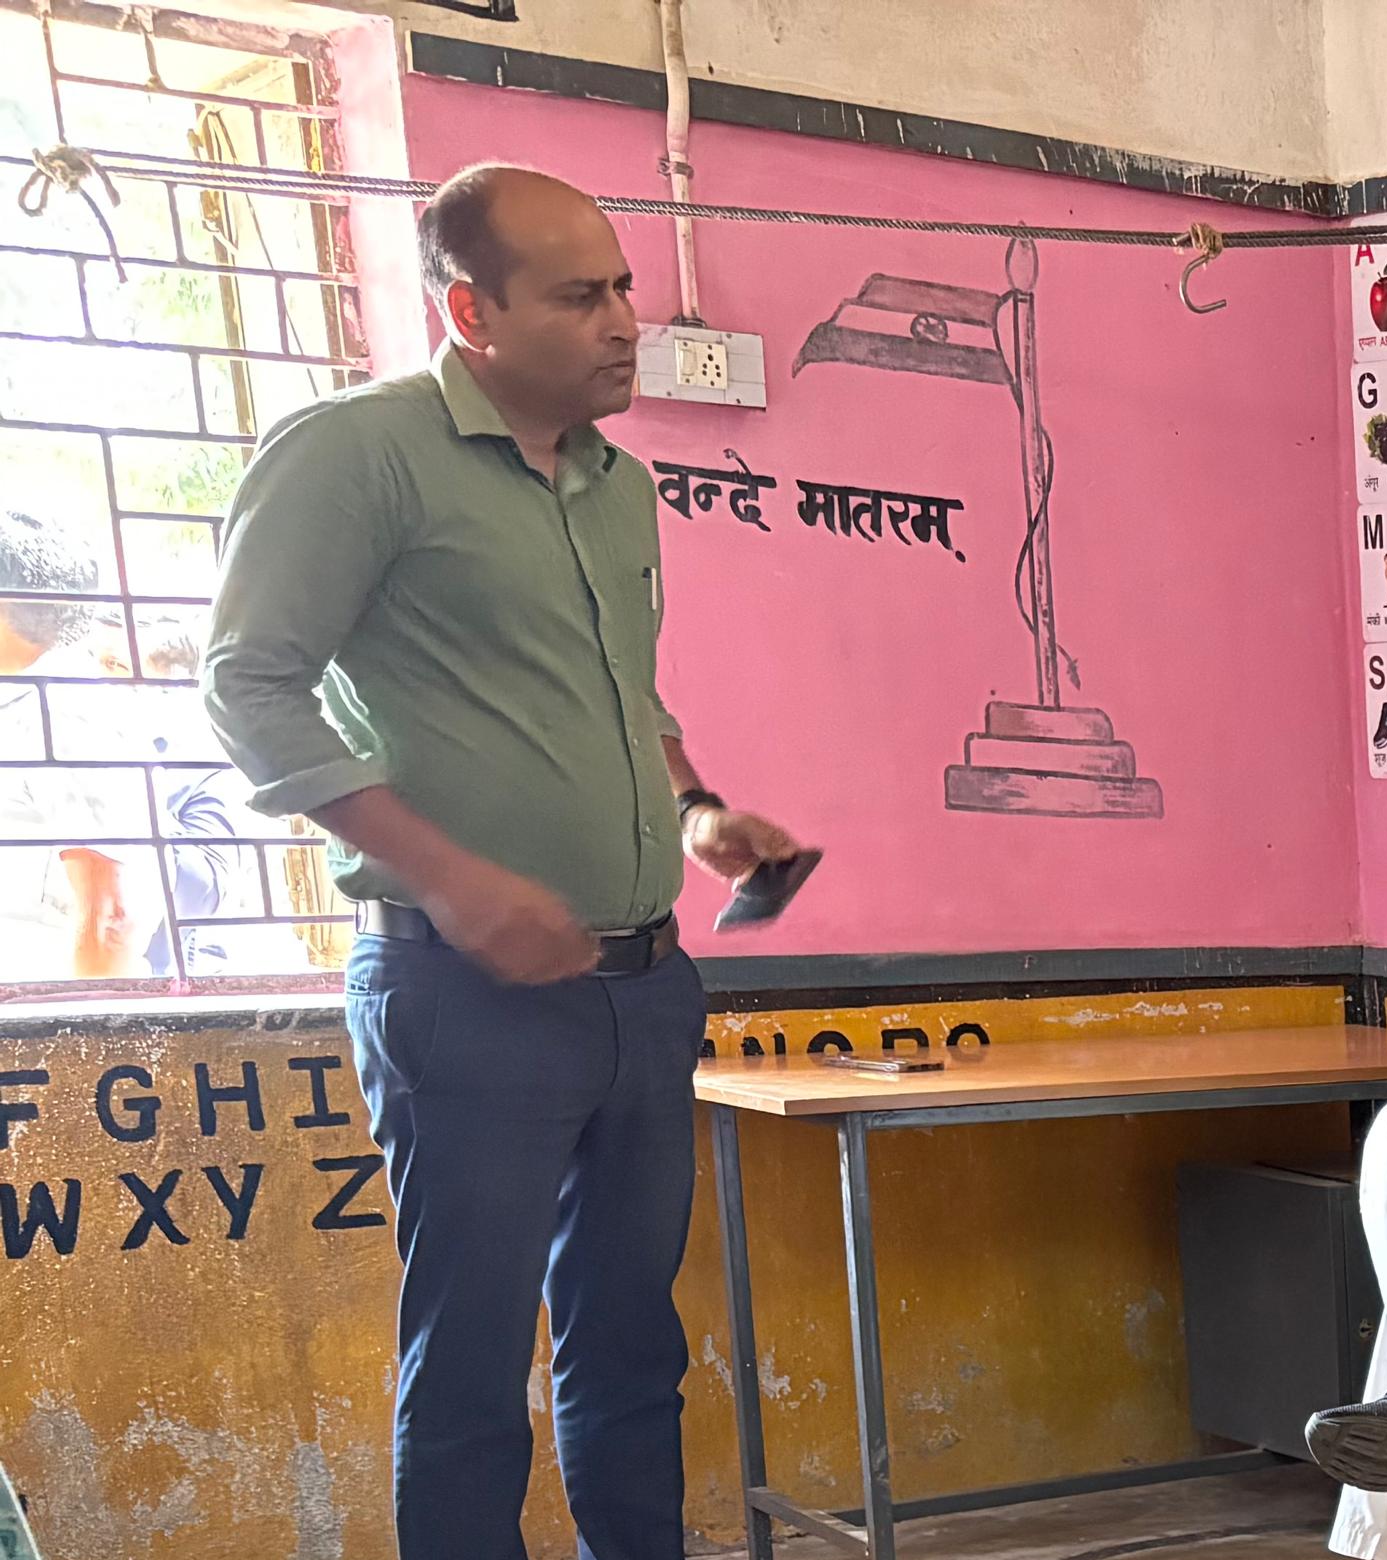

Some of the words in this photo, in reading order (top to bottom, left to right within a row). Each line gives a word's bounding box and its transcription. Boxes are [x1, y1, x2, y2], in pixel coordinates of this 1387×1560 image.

[1358, 373, 1378, 409] G
[652, 447, 777, 532] वन्दे
[1363, 514, 1383, 550] M
[1369, 656, 1385, 690] S
[96, 1065, 161, 1142] G
[194, 1061, 265, 1136] H
[288, 1055, 350, 1128] I
[0, 1178, 81, 1259] W
[118, 1169, 190, 1250] X
[201, 1164, 264, 1239] Y
[312, 1155, 386, 1230] Z
